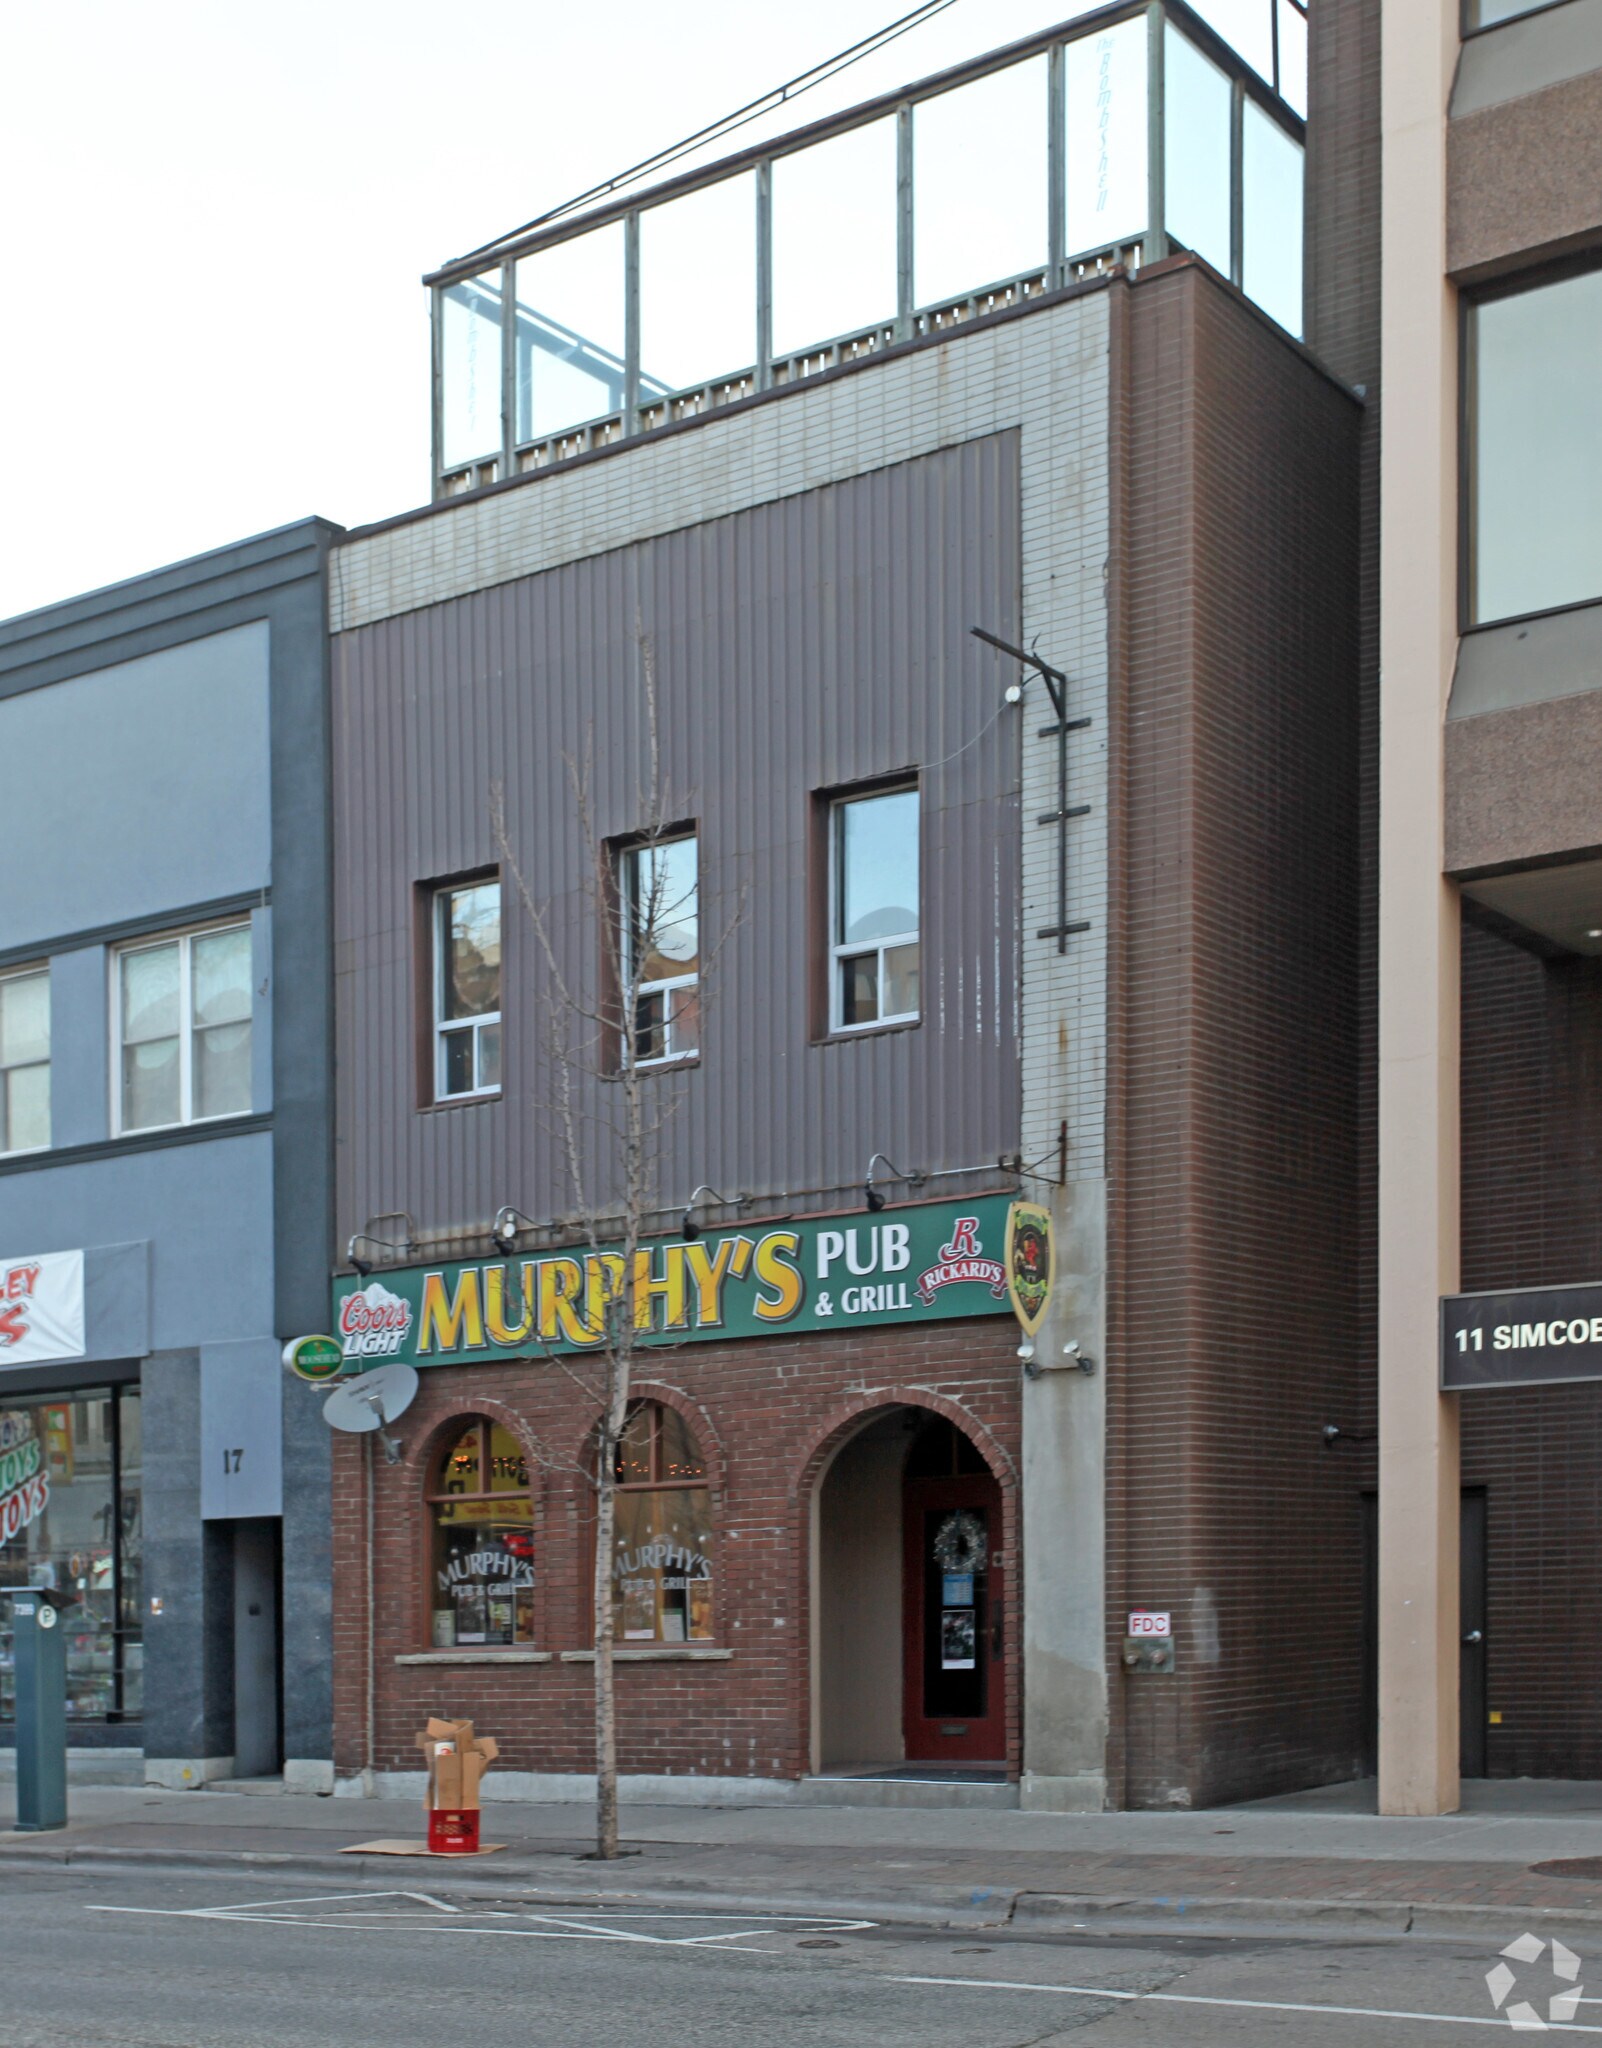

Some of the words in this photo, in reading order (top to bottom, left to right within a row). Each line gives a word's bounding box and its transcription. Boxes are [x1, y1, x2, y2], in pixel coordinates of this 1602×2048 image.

[0, 1261, 41, 1300] EY
[416, 1231, 803, 1355] MURPHY'S
[817, 1223, 911, 1279] PUB
[924, 1262, 1002, 1290] RICKARD'S
[341, 1293, 408, 1333] Coors
[814, 1291, 834, 1317] &
[841, 1282, 913, 1314] GRILL
[343, 1330, 407, 1357] LIGHT
[1455, 1328, 1483, 1353] 11
[1493, 1317, 1602, 1351] SIMCOE
[223, 1449, 244, 1475] 17
[437, 1551, 535, 1591] MURPHY'S
[1132, 1616, 1166, 1632] FDC
